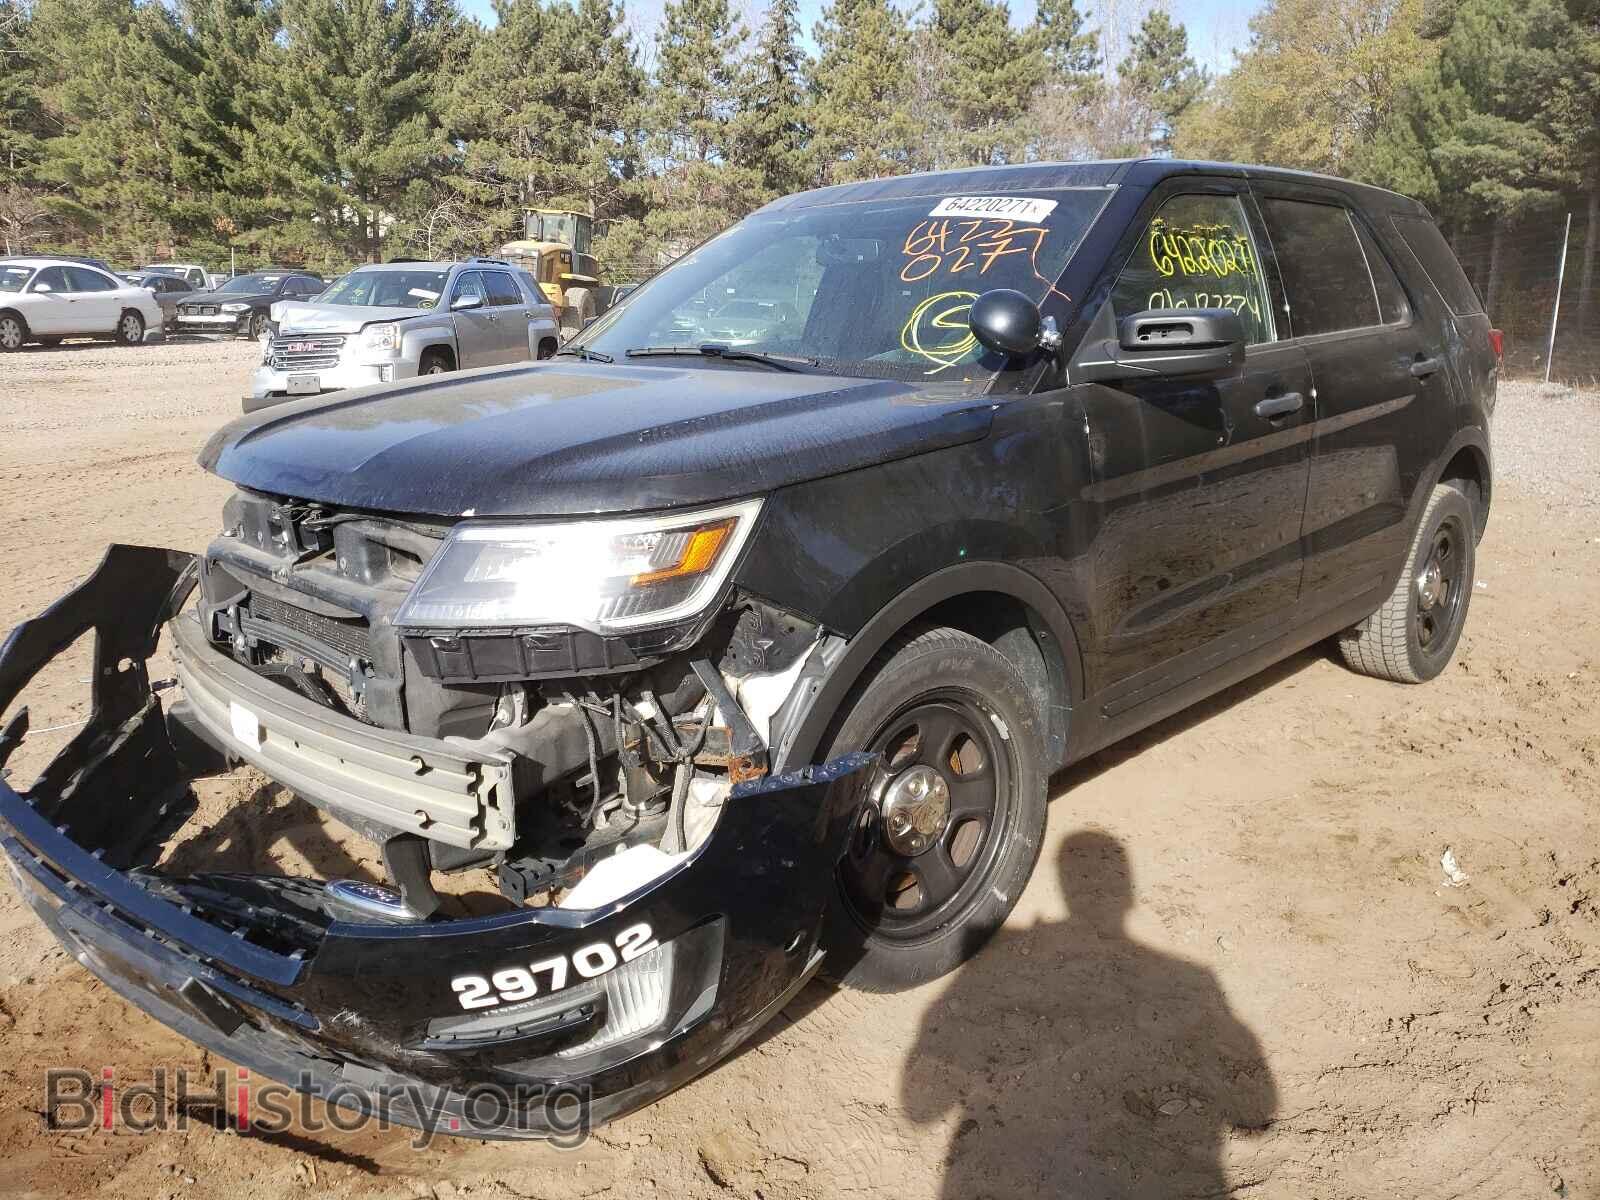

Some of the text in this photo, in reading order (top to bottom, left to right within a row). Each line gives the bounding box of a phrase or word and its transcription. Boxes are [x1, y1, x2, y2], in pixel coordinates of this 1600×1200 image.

[945, 197, 1032, 214] 64220271
[901, 219, 1049, 256] 6422
[287, 341, 321, 352] GMC
[451, 923, 659, 1010] 29702
